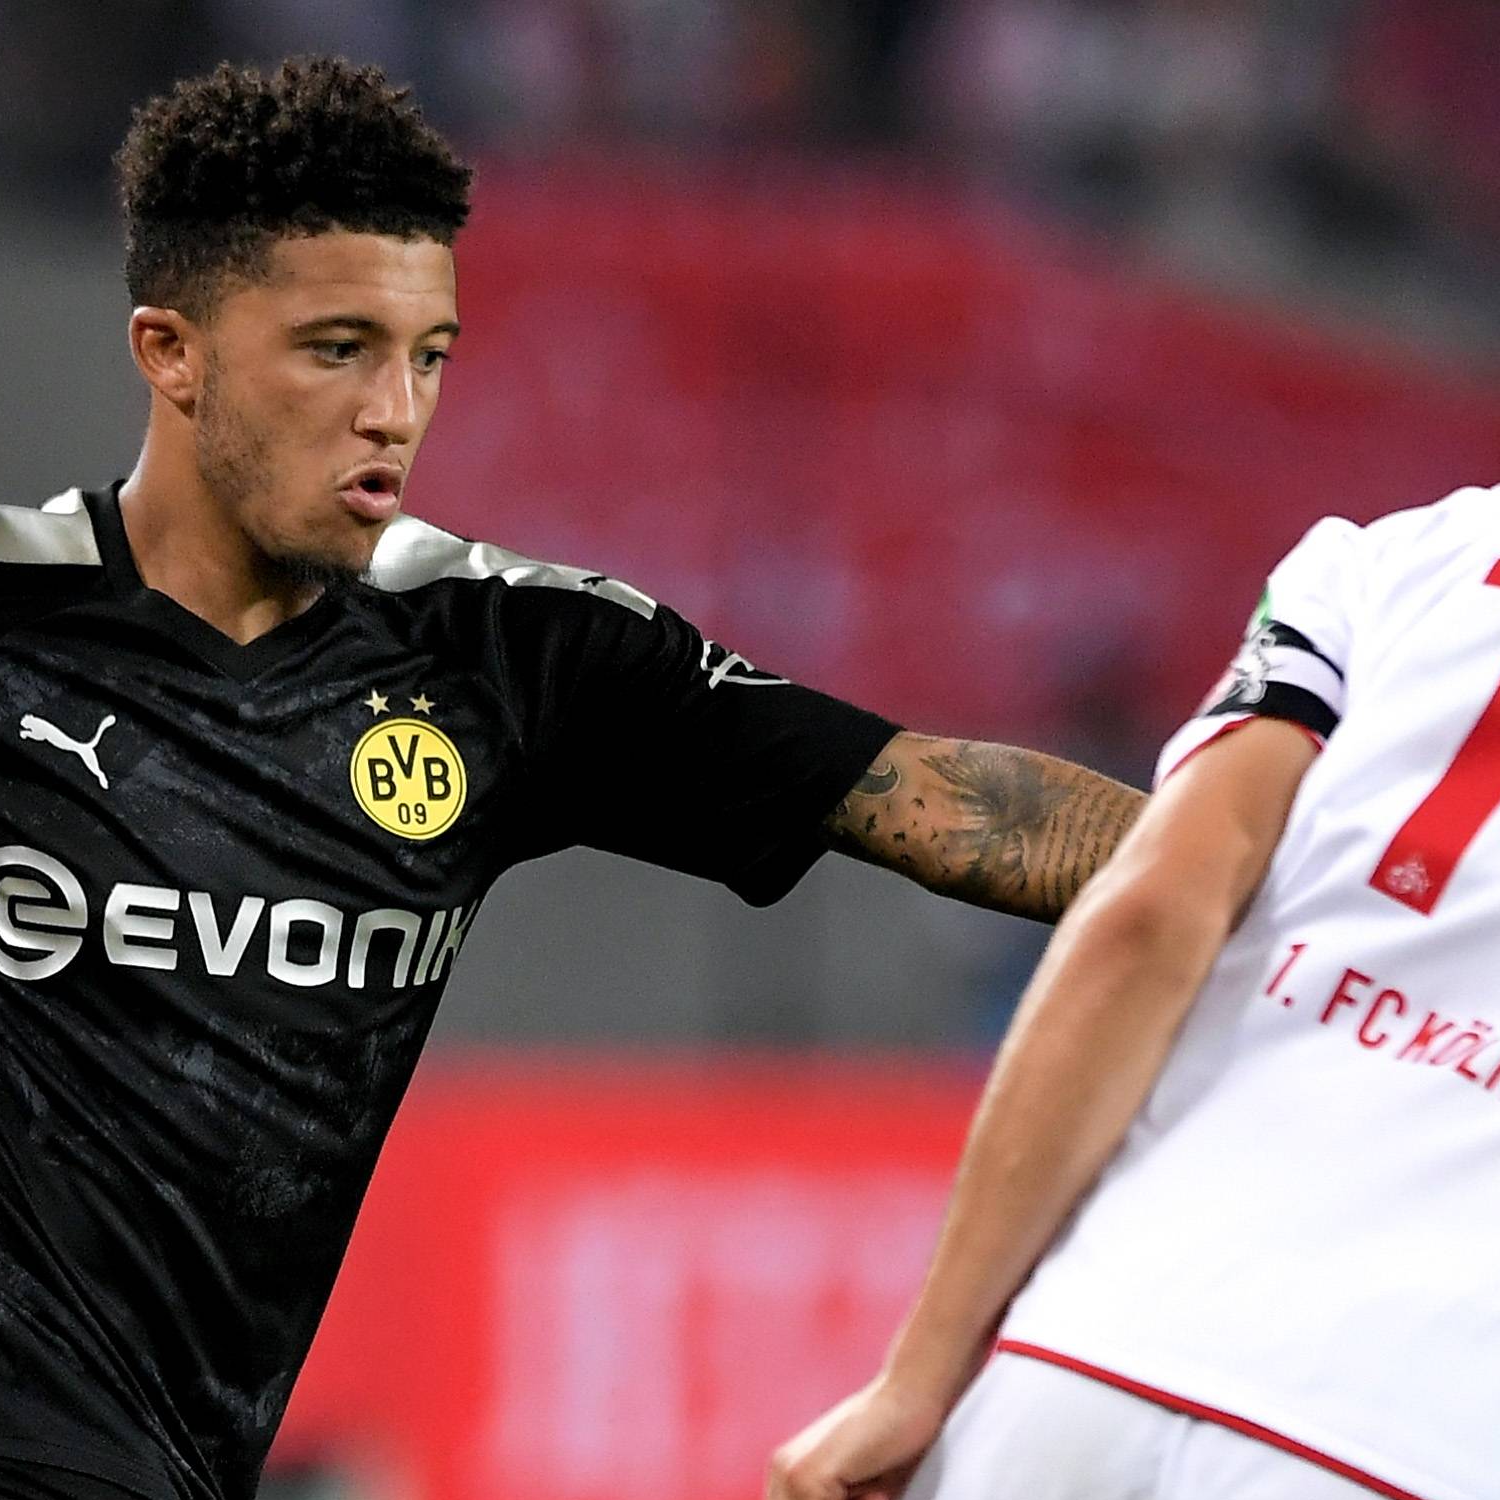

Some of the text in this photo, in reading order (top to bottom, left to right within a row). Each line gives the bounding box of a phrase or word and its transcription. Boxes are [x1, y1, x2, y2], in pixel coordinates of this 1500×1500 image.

[367, 735, 451, 802] BVB
[398, 802, 427, 825] 09
[103, 882, 478, 989] EVONIK
[1265, 942, 1308, 1008] 1.
[1319, 966, 1410, 1050] FC
